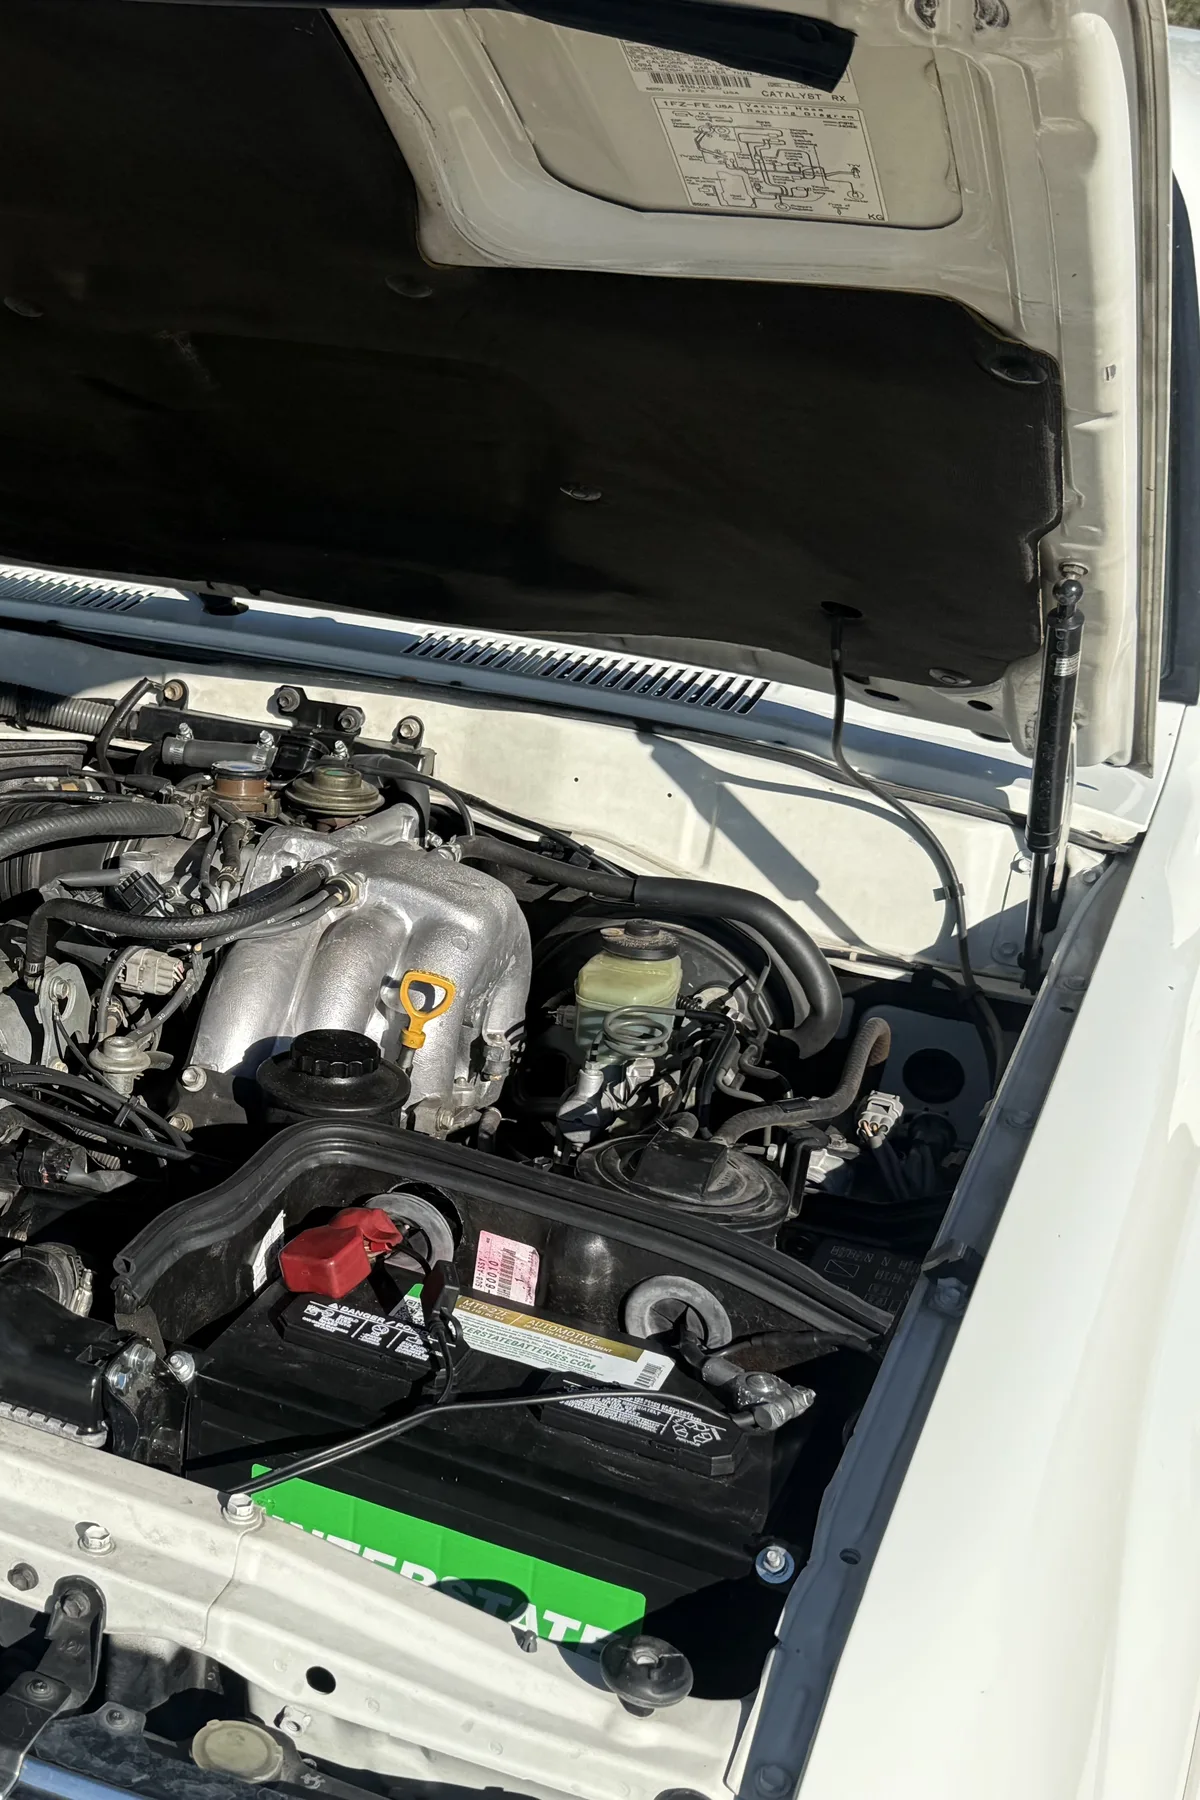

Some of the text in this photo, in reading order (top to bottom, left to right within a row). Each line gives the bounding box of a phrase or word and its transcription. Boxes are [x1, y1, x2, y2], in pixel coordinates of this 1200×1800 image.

[663, 100, 711, 109] 1FZ-FE
[761, 90, 847, 102] CATALYST RX
[339, 1304, 385, 1323] DANGER
[462, 1299, 509, 1316] MTP-27F
[528, 1319, 599, 1344] AUTOMOTIVE
